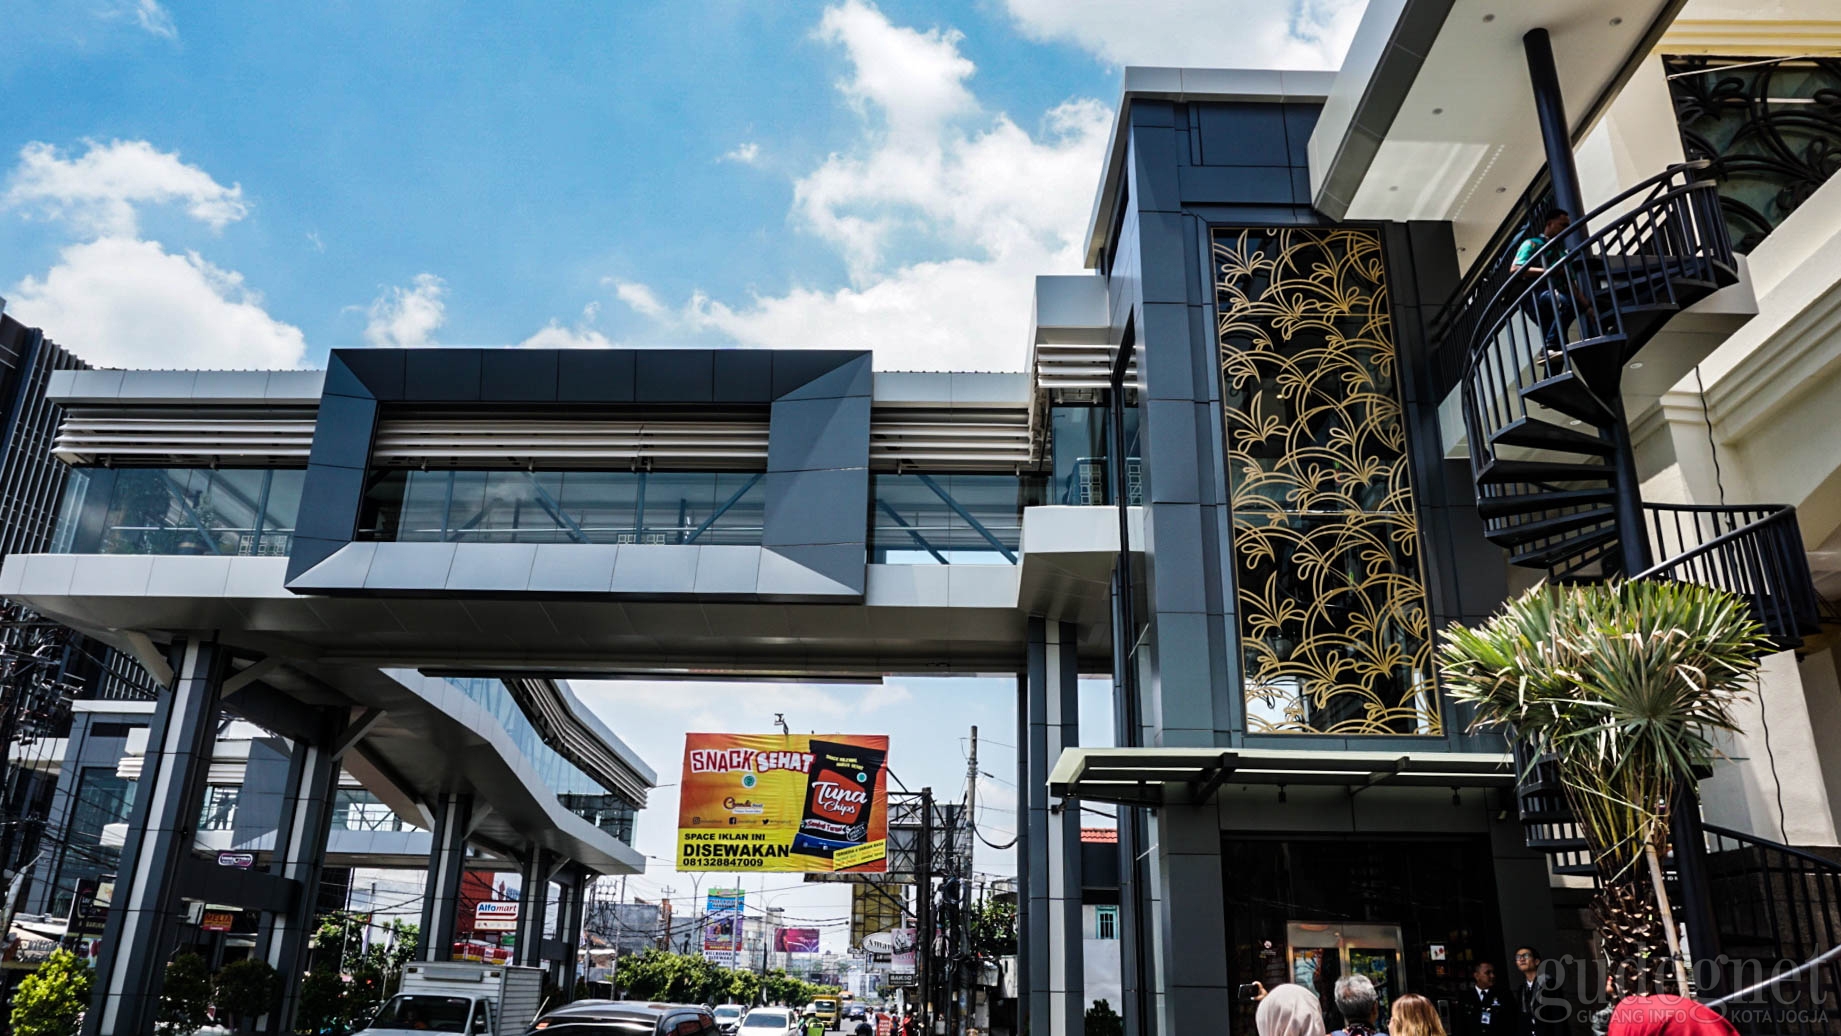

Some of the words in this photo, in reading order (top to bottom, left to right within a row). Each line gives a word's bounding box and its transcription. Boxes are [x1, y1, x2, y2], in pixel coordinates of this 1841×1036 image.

[691, 749, 756, 773] SNACK
[756, 750, 816, 773] SEHAT
[812, 781, 867, 804] Tuna
[824, 800, 855, 816] Chips
[684, 833, 716, 841] SPACE
[718, 833, 748, 841] IKLAN
[752, 833, 766, 841] INI
[683, 844, 789, 857] DISEWAKAN
[683, 858, 764, 867] 081328847009
[478, 904, 517, 912] Alfamart
